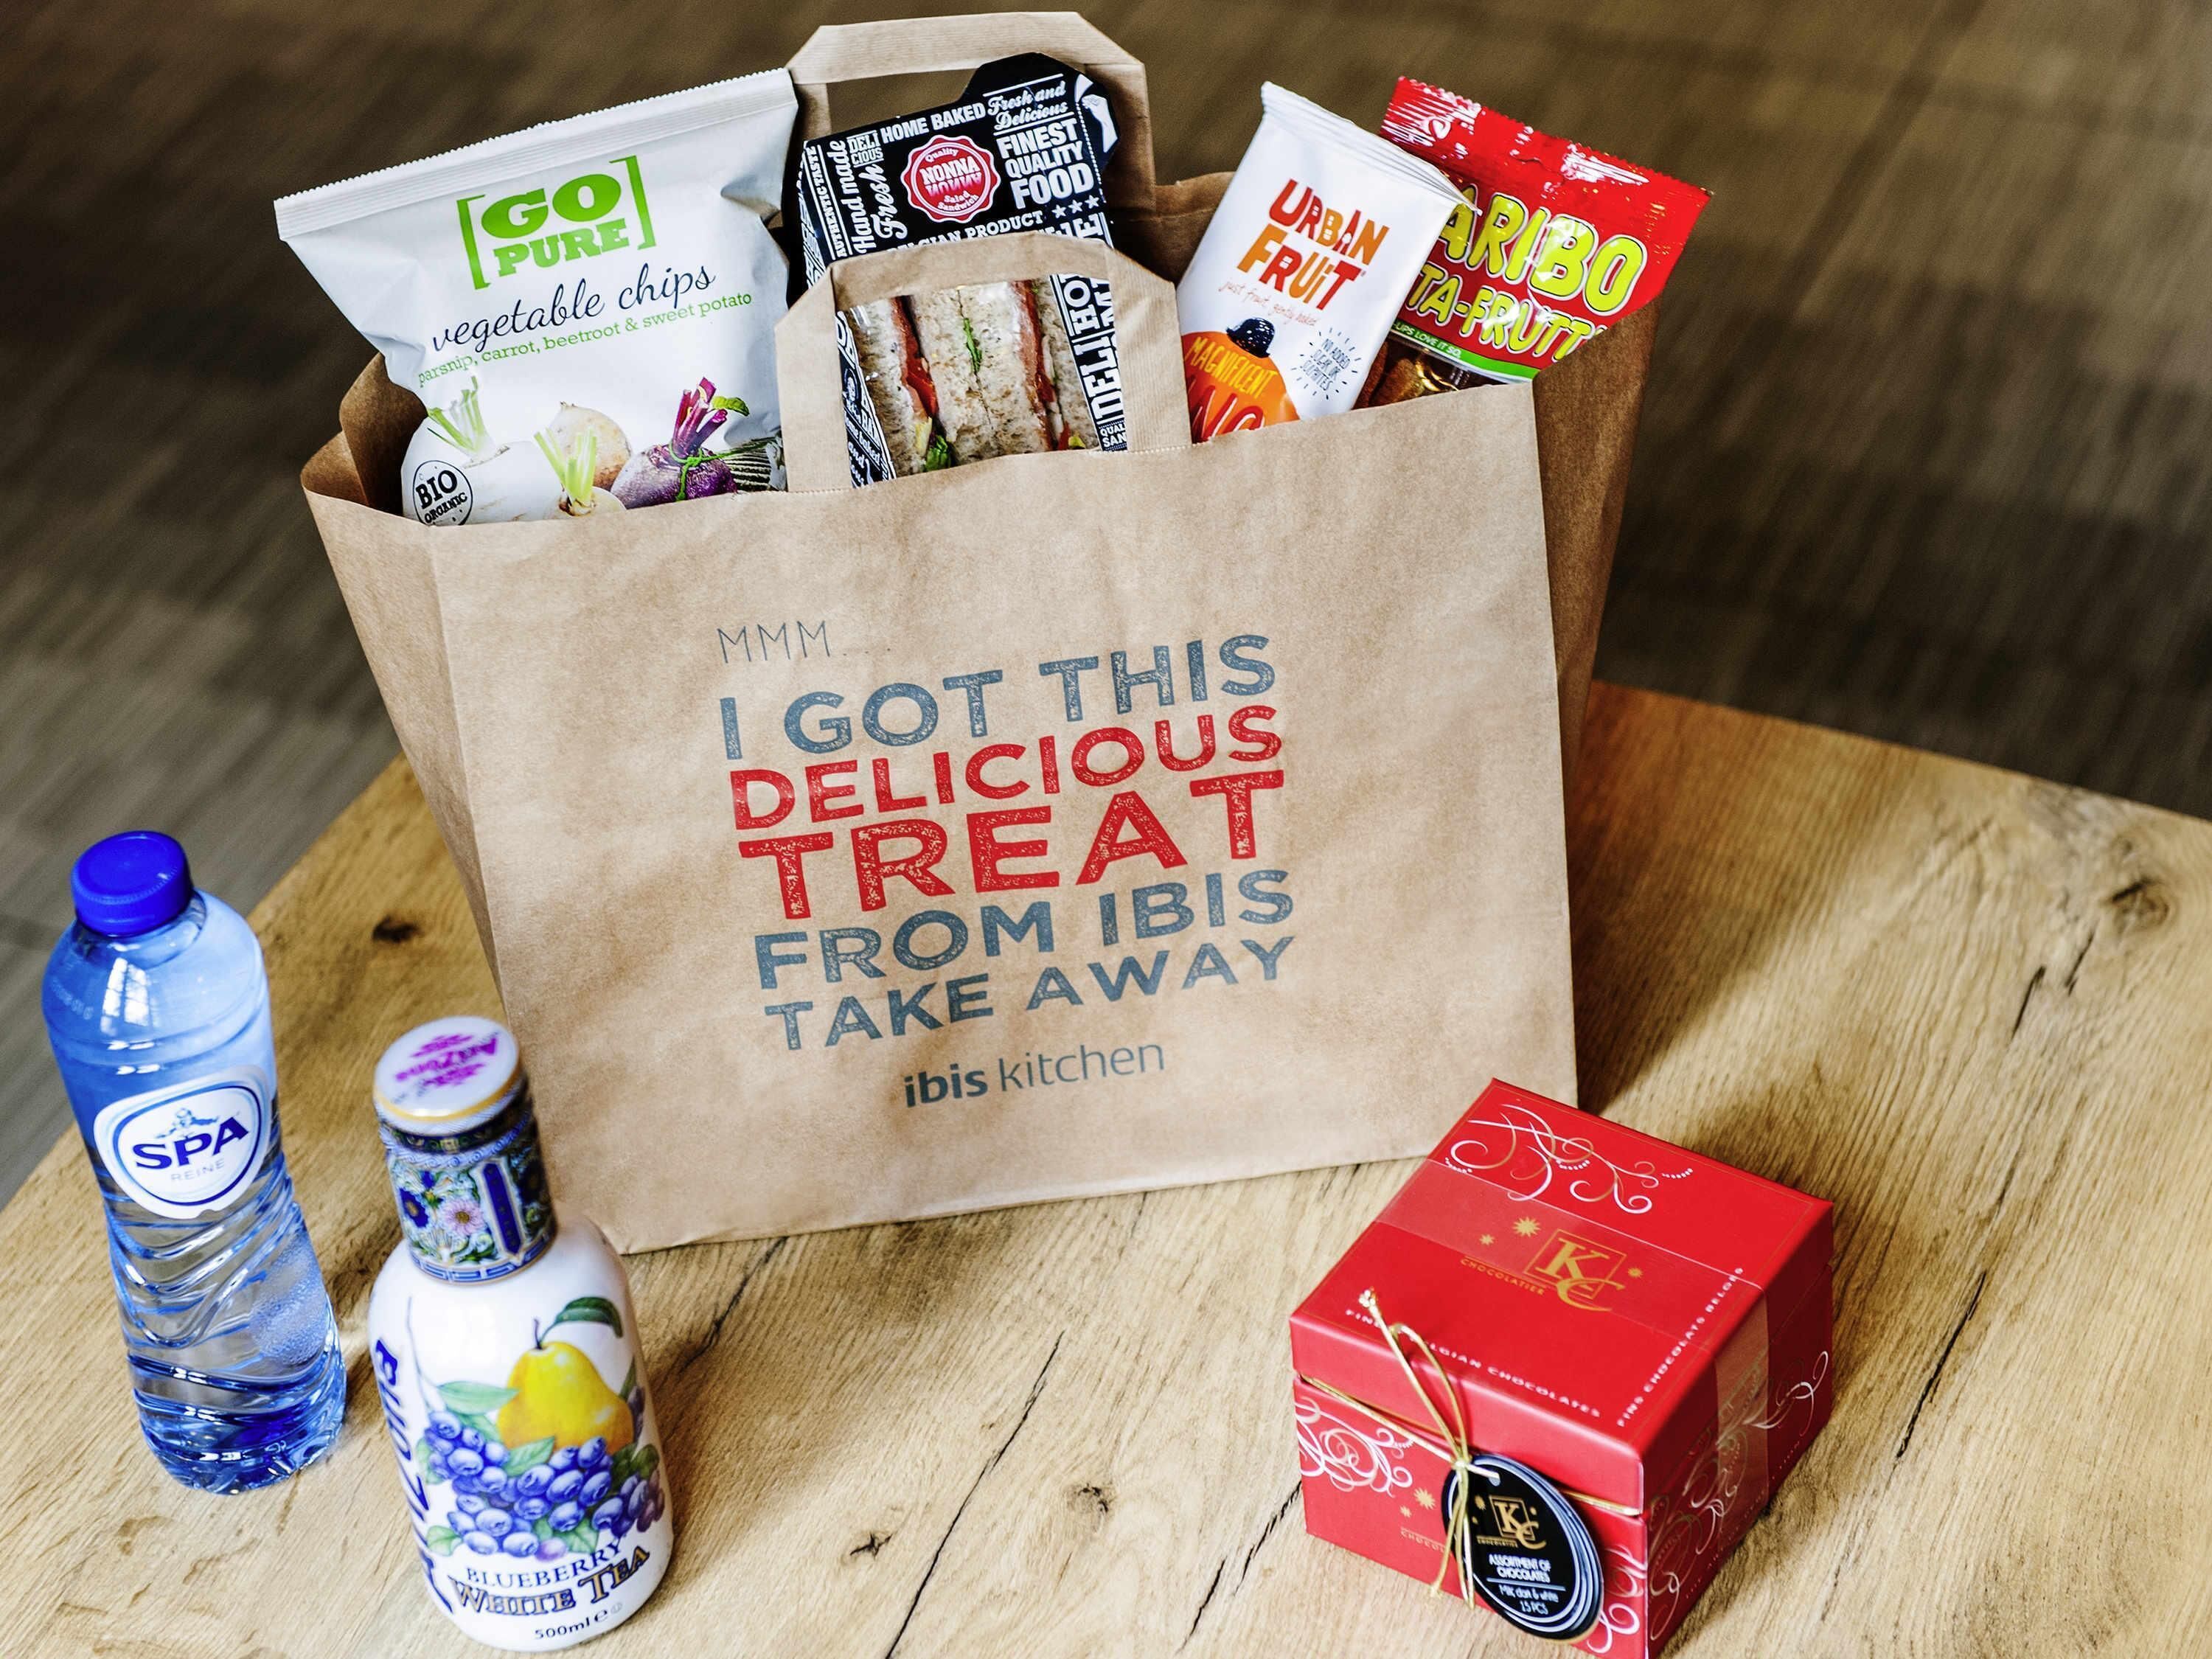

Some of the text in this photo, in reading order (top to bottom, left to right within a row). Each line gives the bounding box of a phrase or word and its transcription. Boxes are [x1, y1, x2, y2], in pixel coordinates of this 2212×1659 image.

[880, 102, 987, 145] HOME BAKED
[987, 80, 1067, 116] Fresh and
[993, 102, 1068, 131] Delicious
[847, 133, 881, 154] DELI
[850, 147, 885, 167] CIOUS
[924, 147, 959, 163] Quality
[996, 117, 1079, 160] FINEST
[1004, 140, 1084, 179] QUALITY
[804, 146, 825, 187] TASTE
[919, 156, 981, 185] NONNA
[1009, 162, 1095, 210] FOOD
[481, 173, 622, 239] GO
[817, 187, 848, 258] AUTHENTIC
[827, 139, 877, 254] Hand made
[858, 163, 908, 240] Fresh
[937, 194, 980, 212] Sandwich
[943, 190, 971, 204] Salad
[1268, 178, 1390, 266] URBAN
[493, 218, 630, 277] PURE
[966, 210, 1045, 239] PRODUCT
[1438, 184, 1648, 316] ARIBO
[432, 262, 717, 353] vegetable chips
[1405, 263, 1607, 362] TA-FRUTT
[418, 293, 753, 389] parsnip, carrot, beetroot & sweet potato
[1185, 335, 1278, 399] MAGNIFICENT
[1414, 332, 1436, 347] LOVE
[1436, 340, 1448, 350] IT
[1073, 335, 1124, 420] DELI
[415, 470, 458, 510] BIO
[424, 492, 468, 524] ORGANIC
[719, 634, 1277, 760] I GOT THIS
[728, 705, 1283, 831] DELICIOUS
[738, 769, 1284, 920] TREAT
[754, 869, 1294, 990] FROM IBIS
[765, 936, 1295, 1051] TAKE AWAY
[903, 1044, 1165, 1108] ibis kitchen
[132, 1116, 249, 1170] SPA
[170, 1158, 226, 1183] REINE
[1460, 1258, 1545, 1295] CHOCOLATIER
[1486, 1365, 1601, 1419] CHOCOLATES
[447, 1545, 650, 1616] WHITE TEA
[466, 1537, 621, 1589] BLUEBERRY
[1497, 1567, 1551, 1584] CHOCOLATES
[535, 1618, 590, 1639] 500ml
